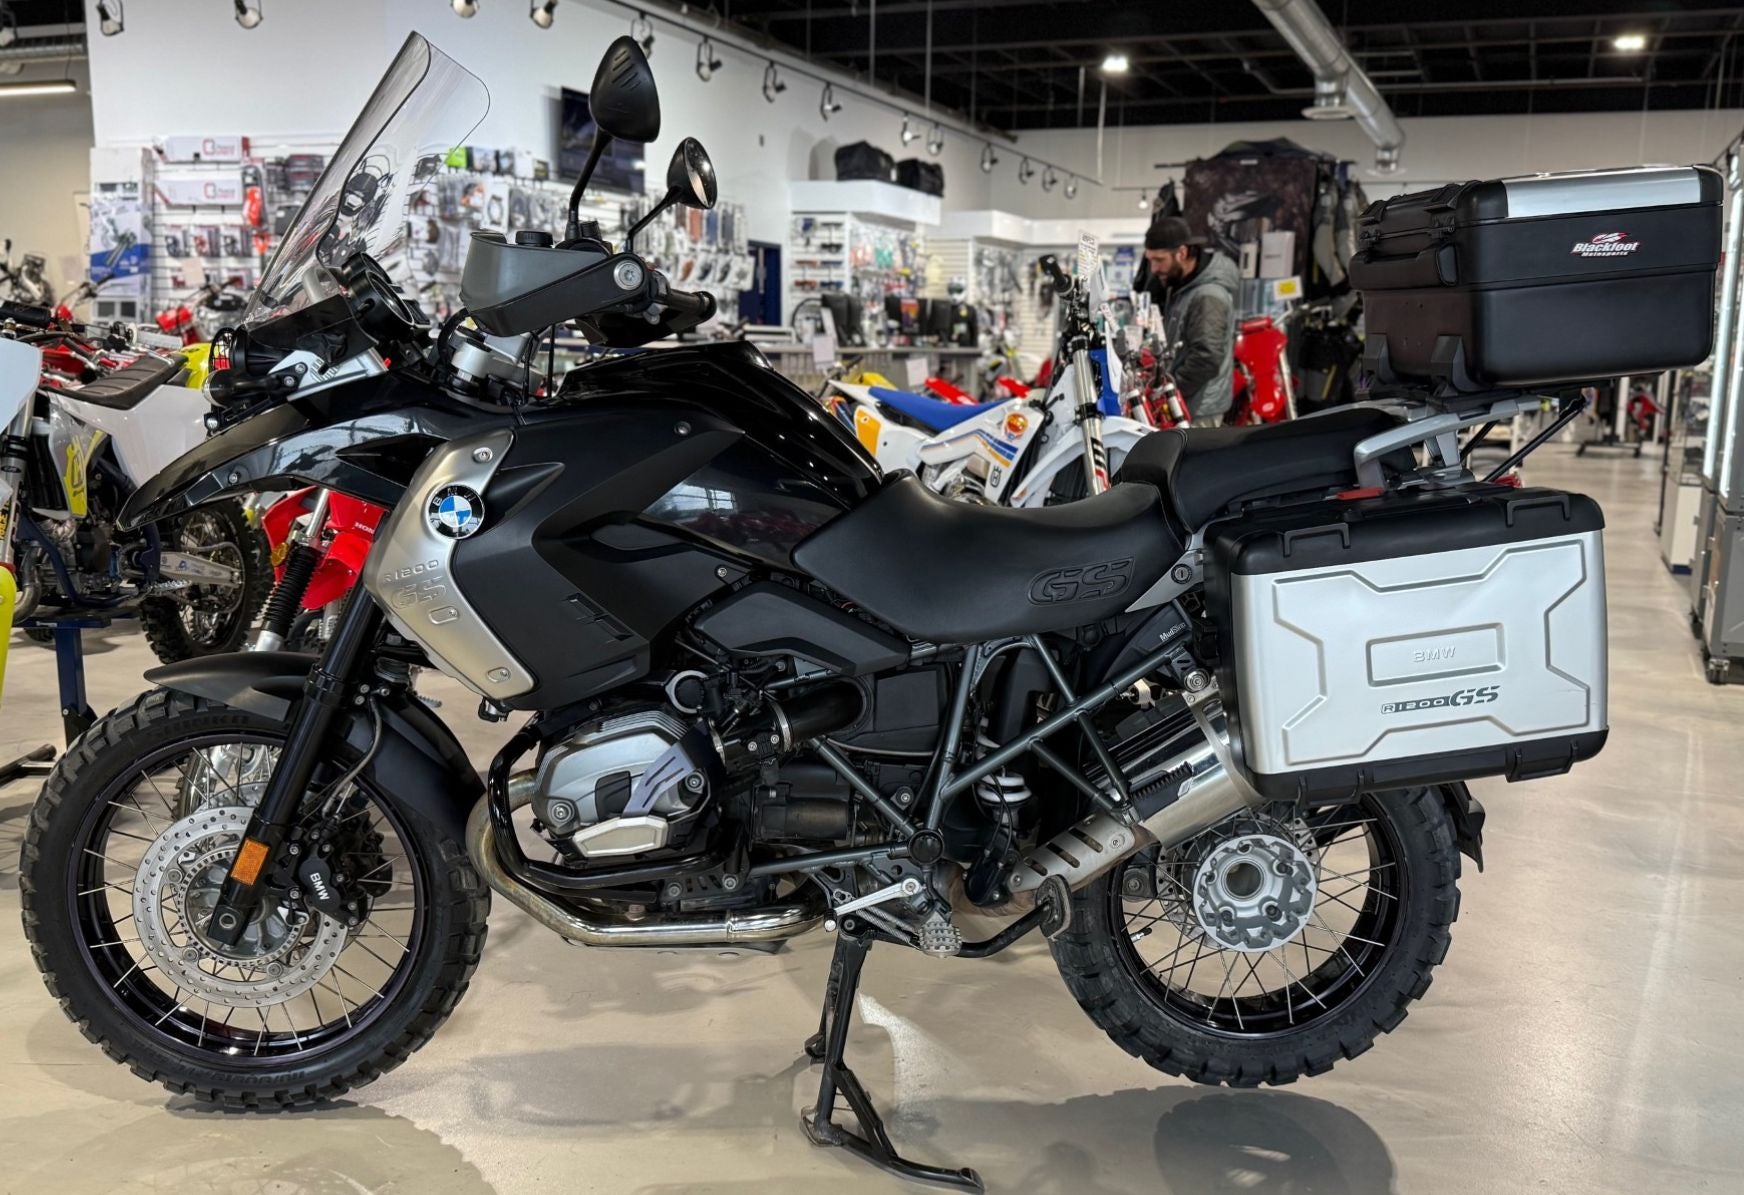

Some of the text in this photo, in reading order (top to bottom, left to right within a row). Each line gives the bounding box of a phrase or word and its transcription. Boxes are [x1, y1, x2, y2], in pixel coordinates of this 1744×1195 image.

[1571, 241, 1639, 253] Blackfoot
[432, 486, 477, 507] BMW
[383, 559, 440, 583] R1200
[1031, 560, 1130, 602] GS
[391, 575, 446, 610] GS
[1413, 645, 1456, 662] BMW
[309, 872, 331, 900] BMW
